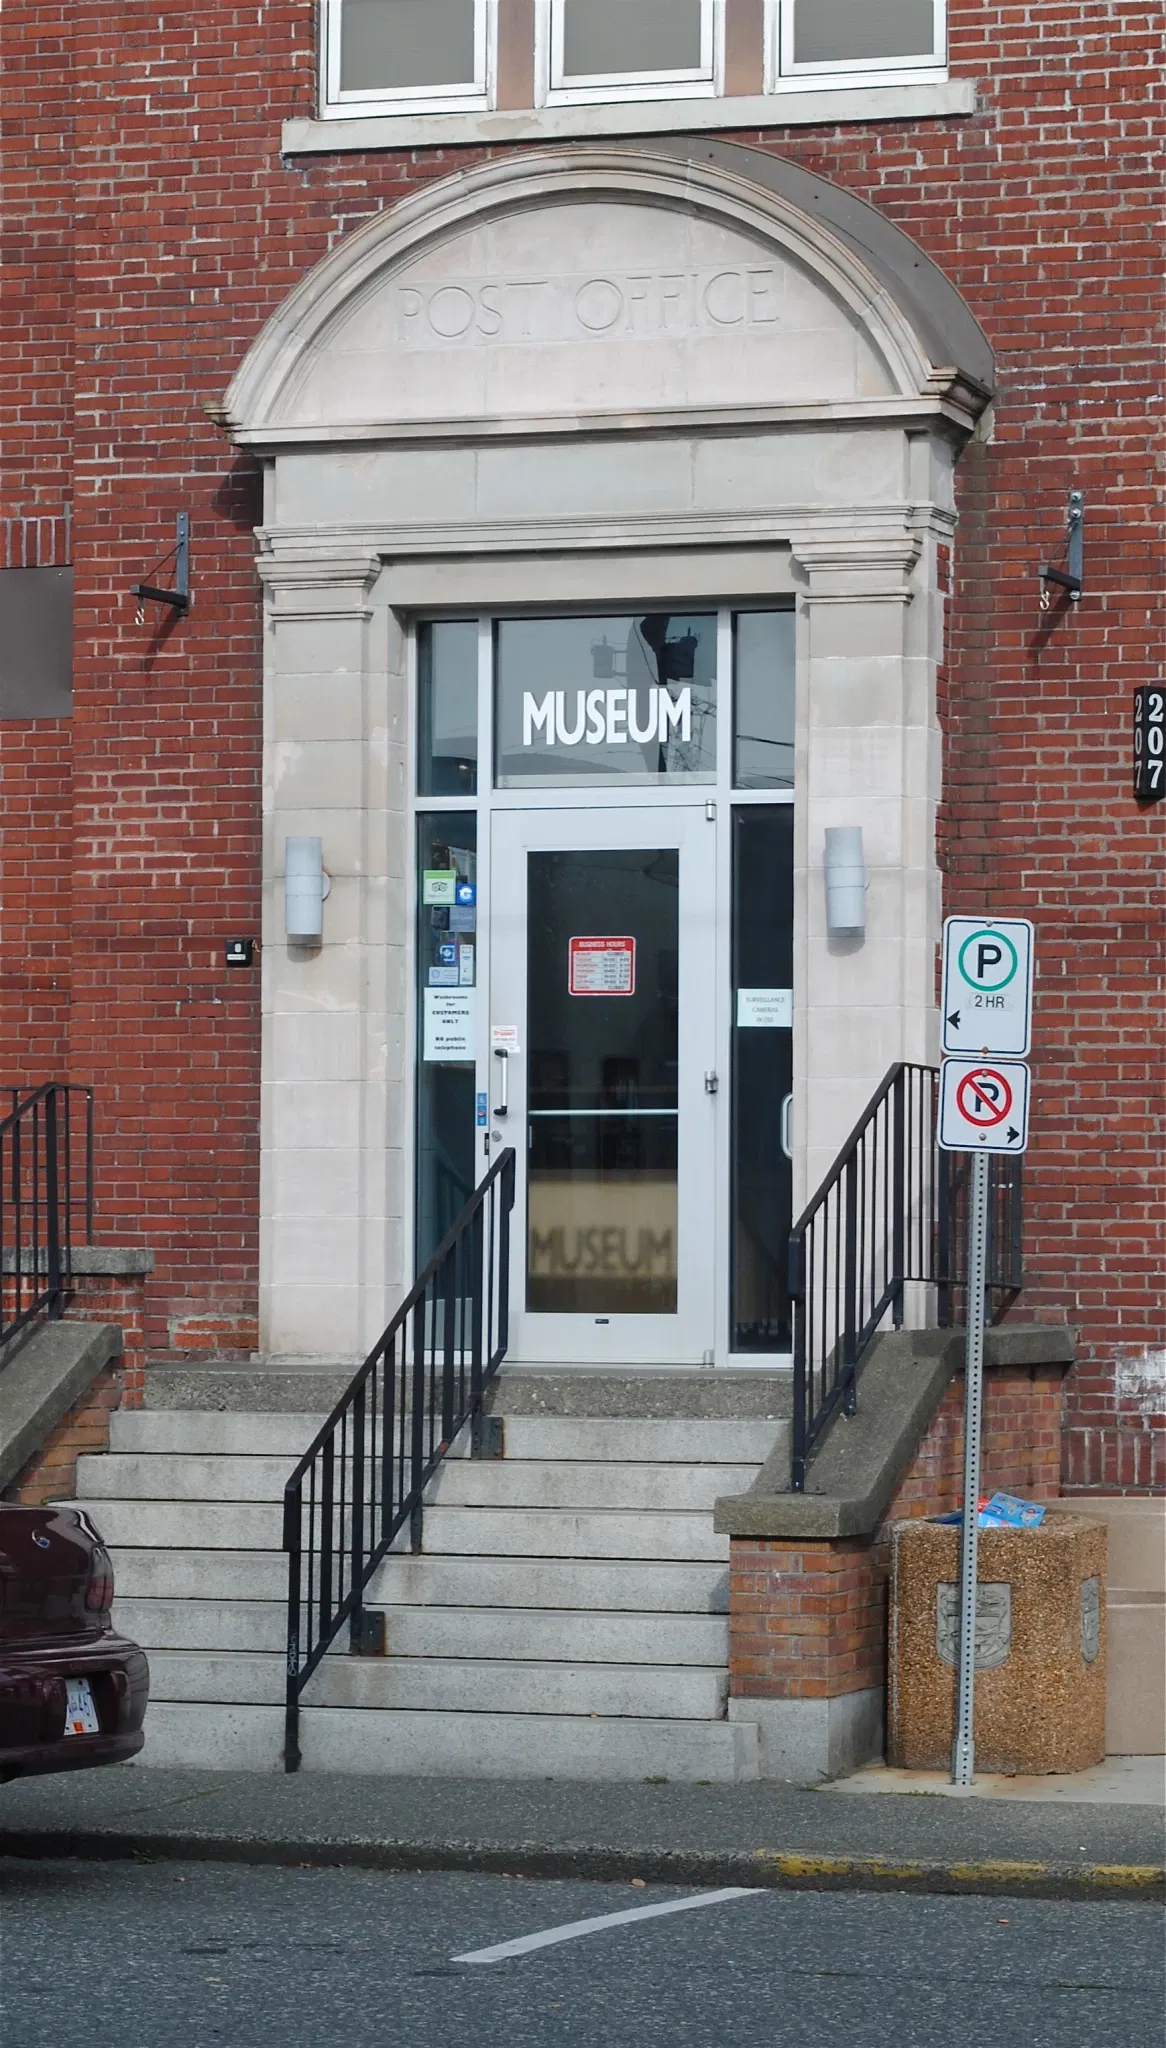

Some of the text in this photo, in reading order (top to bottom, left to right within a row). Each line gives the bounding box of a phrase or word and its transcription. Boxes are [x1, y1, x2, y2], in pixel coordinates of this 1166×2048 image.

[397, 269, 780, 342] POST OFFICE
[523, 687, 691, 746] MUSEUM
[1147, 693, 1165, 789] 207
[977, 943, 1002, 978] P
[974, 995, 1005, 1009] 2 HR
